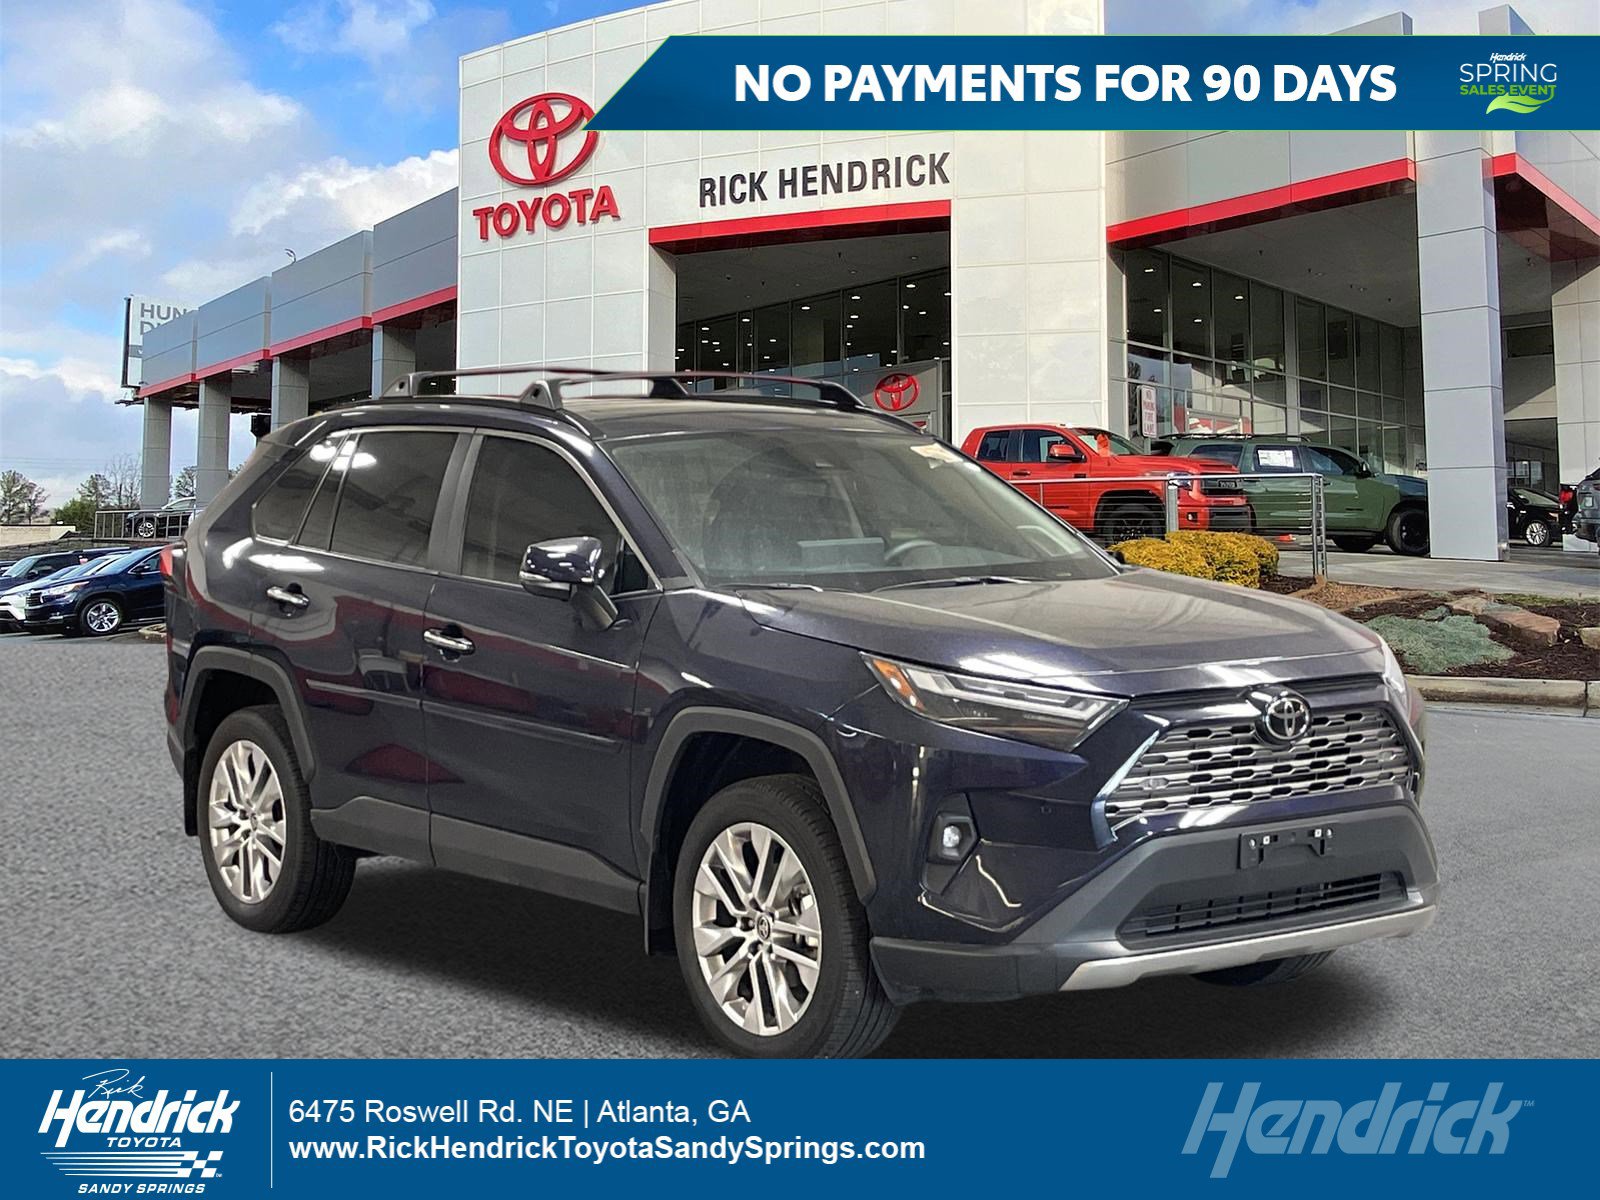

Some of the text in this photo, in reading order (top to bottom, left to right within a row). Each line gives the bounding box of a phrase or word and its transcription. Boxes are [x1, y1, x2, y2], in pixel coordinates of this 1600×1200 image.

[699, 151, 951, 208] RICK HENDRICK
[472, 184, 621, 241] TOYOTA
